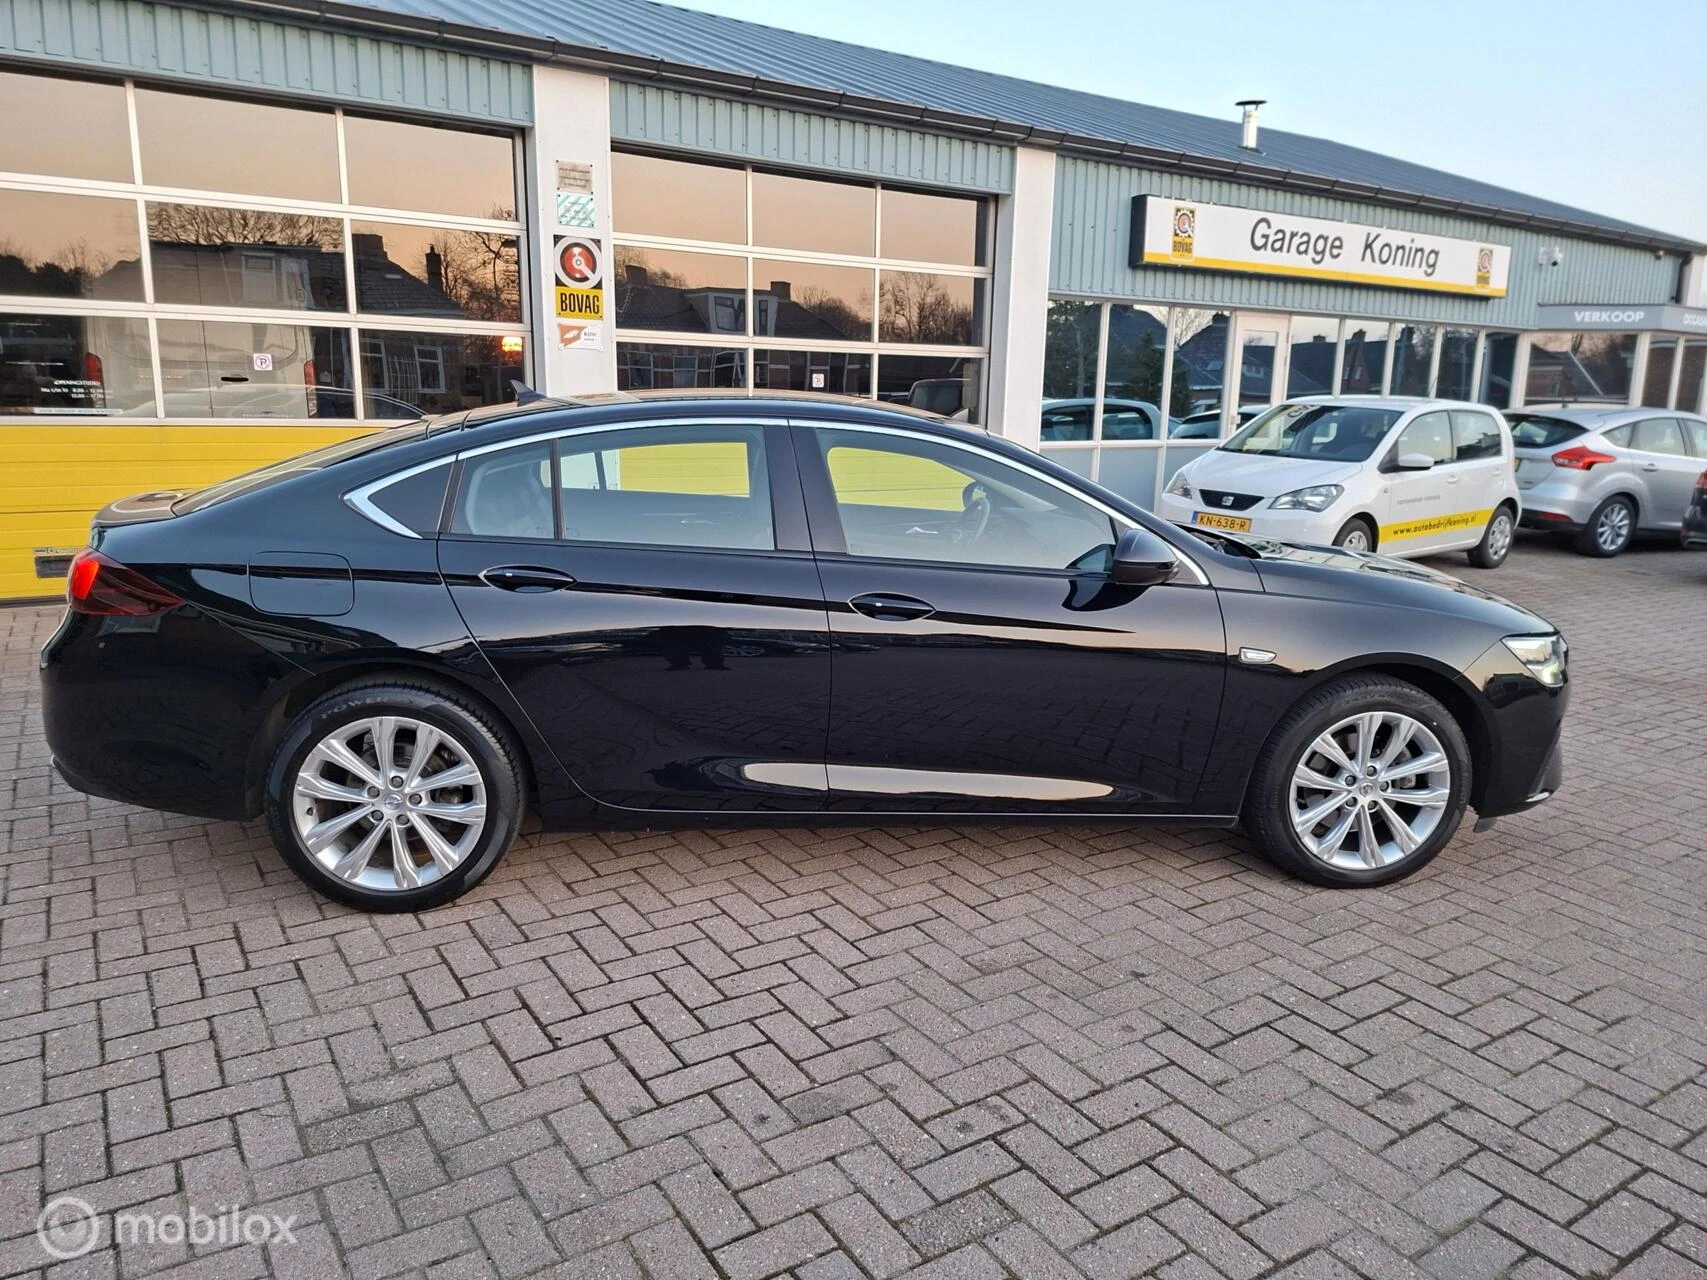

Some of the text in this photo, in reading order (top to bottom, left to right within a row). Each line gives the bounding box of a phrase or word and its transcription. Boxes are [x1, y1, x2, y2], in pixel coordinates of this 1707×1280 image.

[1250, 217, 1440, 277] Garage Koning
[560, 292, 600, 315] BOVAG
[1574, 310, 1645, 323] VERKOOP
[1199, 514, 1246, 531] KN-638-R
